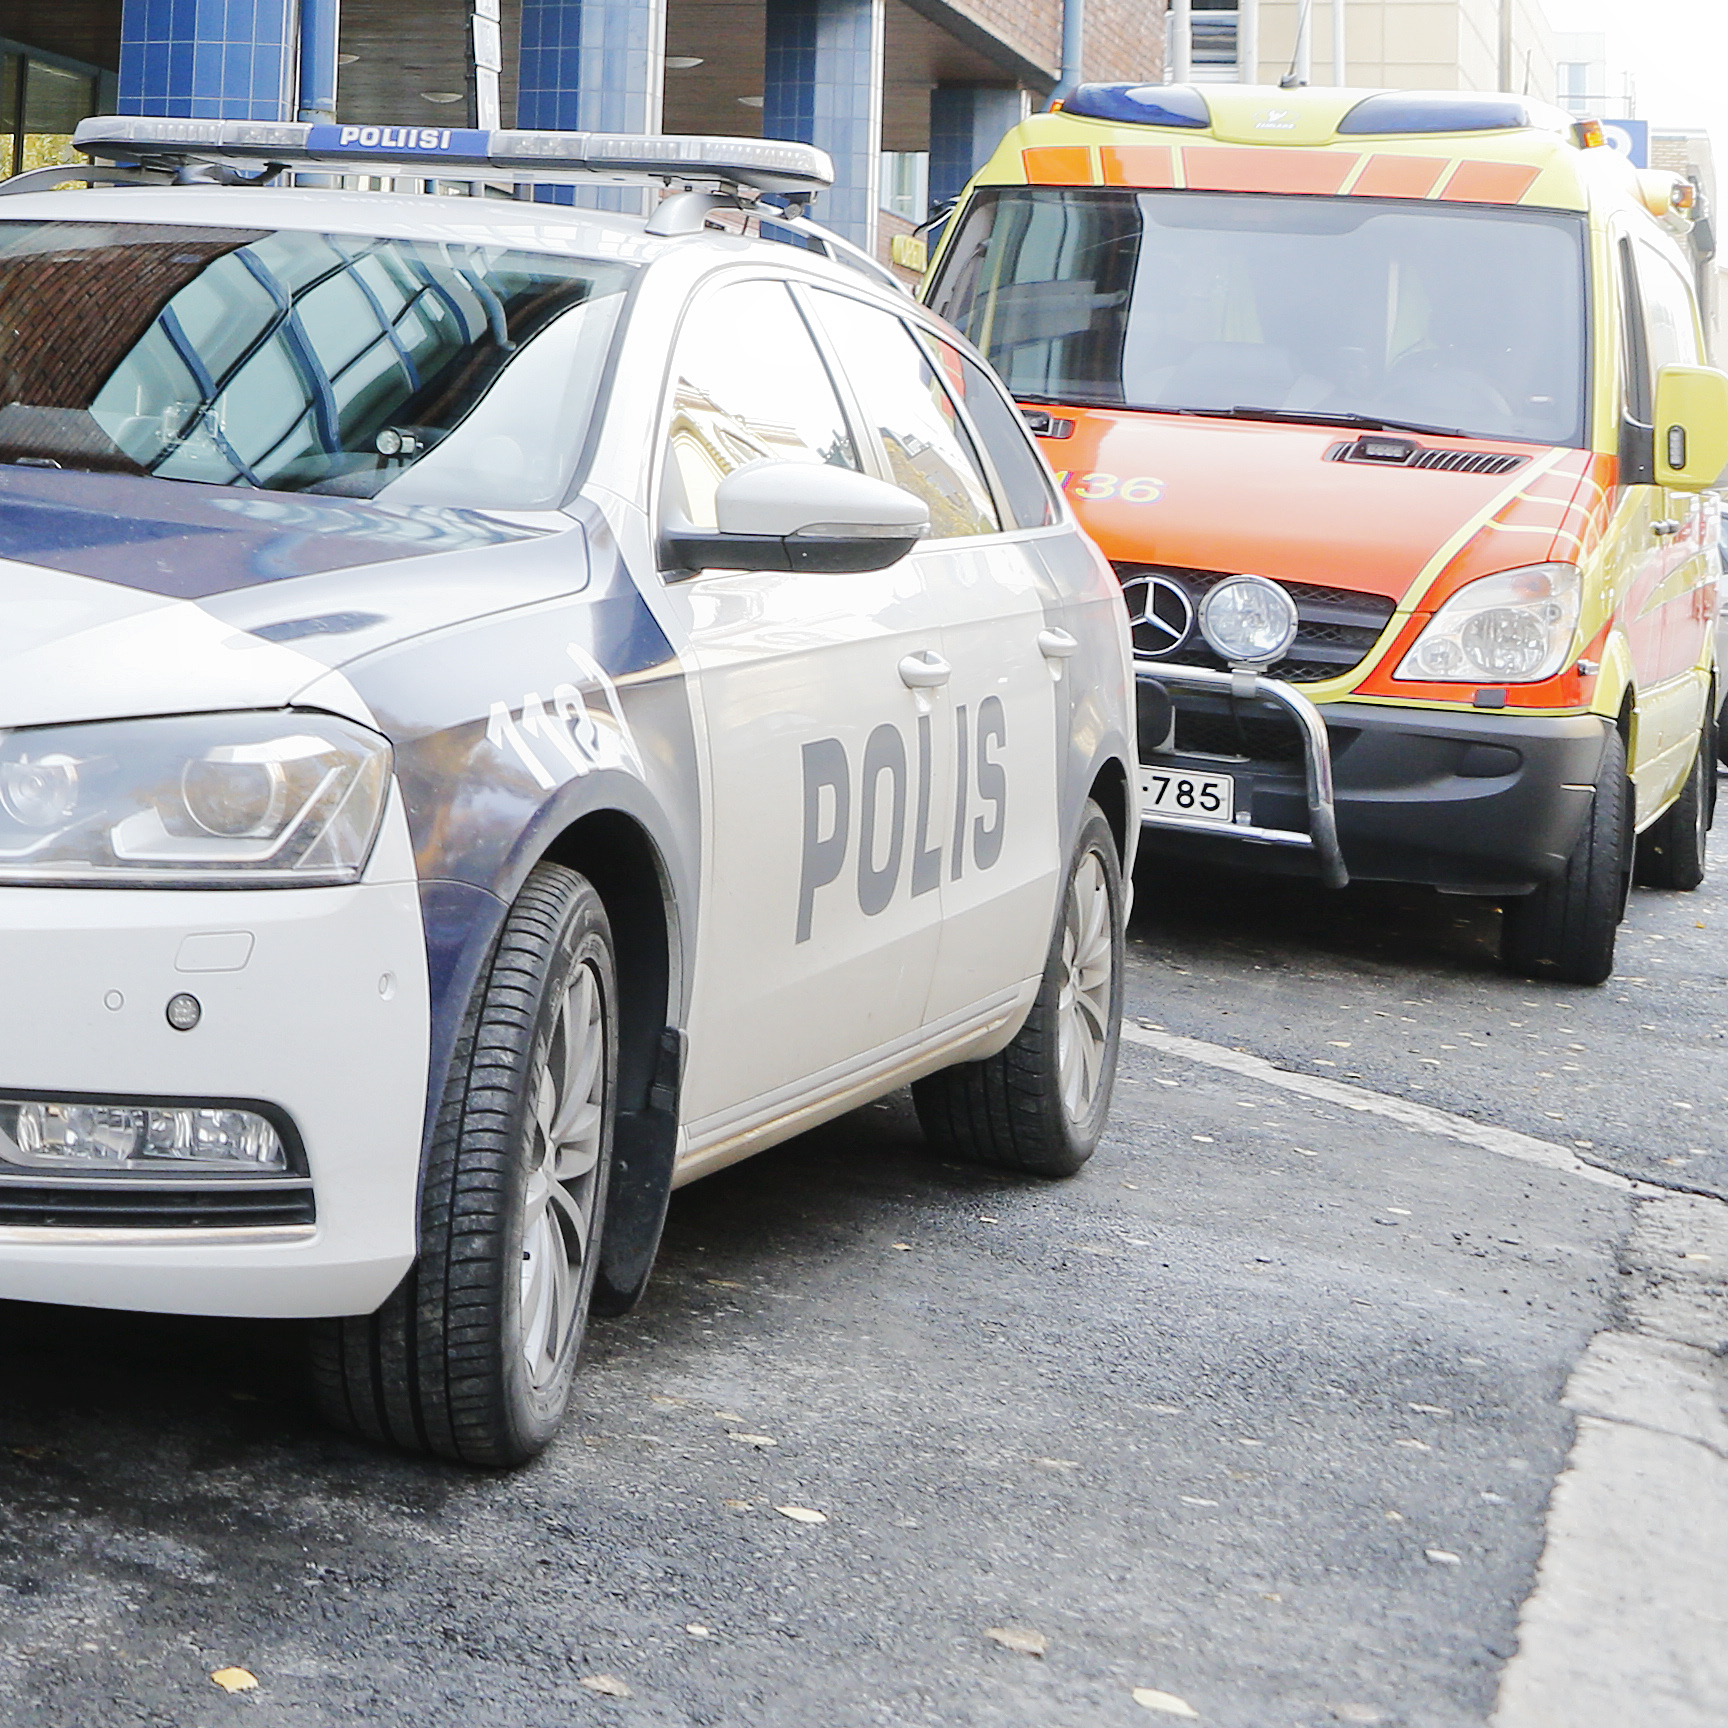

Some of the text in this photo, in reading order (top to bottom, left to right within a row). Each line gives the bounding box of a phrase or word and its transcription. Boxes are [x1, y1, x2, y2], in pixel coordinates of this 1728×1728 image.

[339, 125, 452, 150] POLIISI
[1142, 775, 1221, 812] -785
[796, 695, 1006, 944] POLIS
